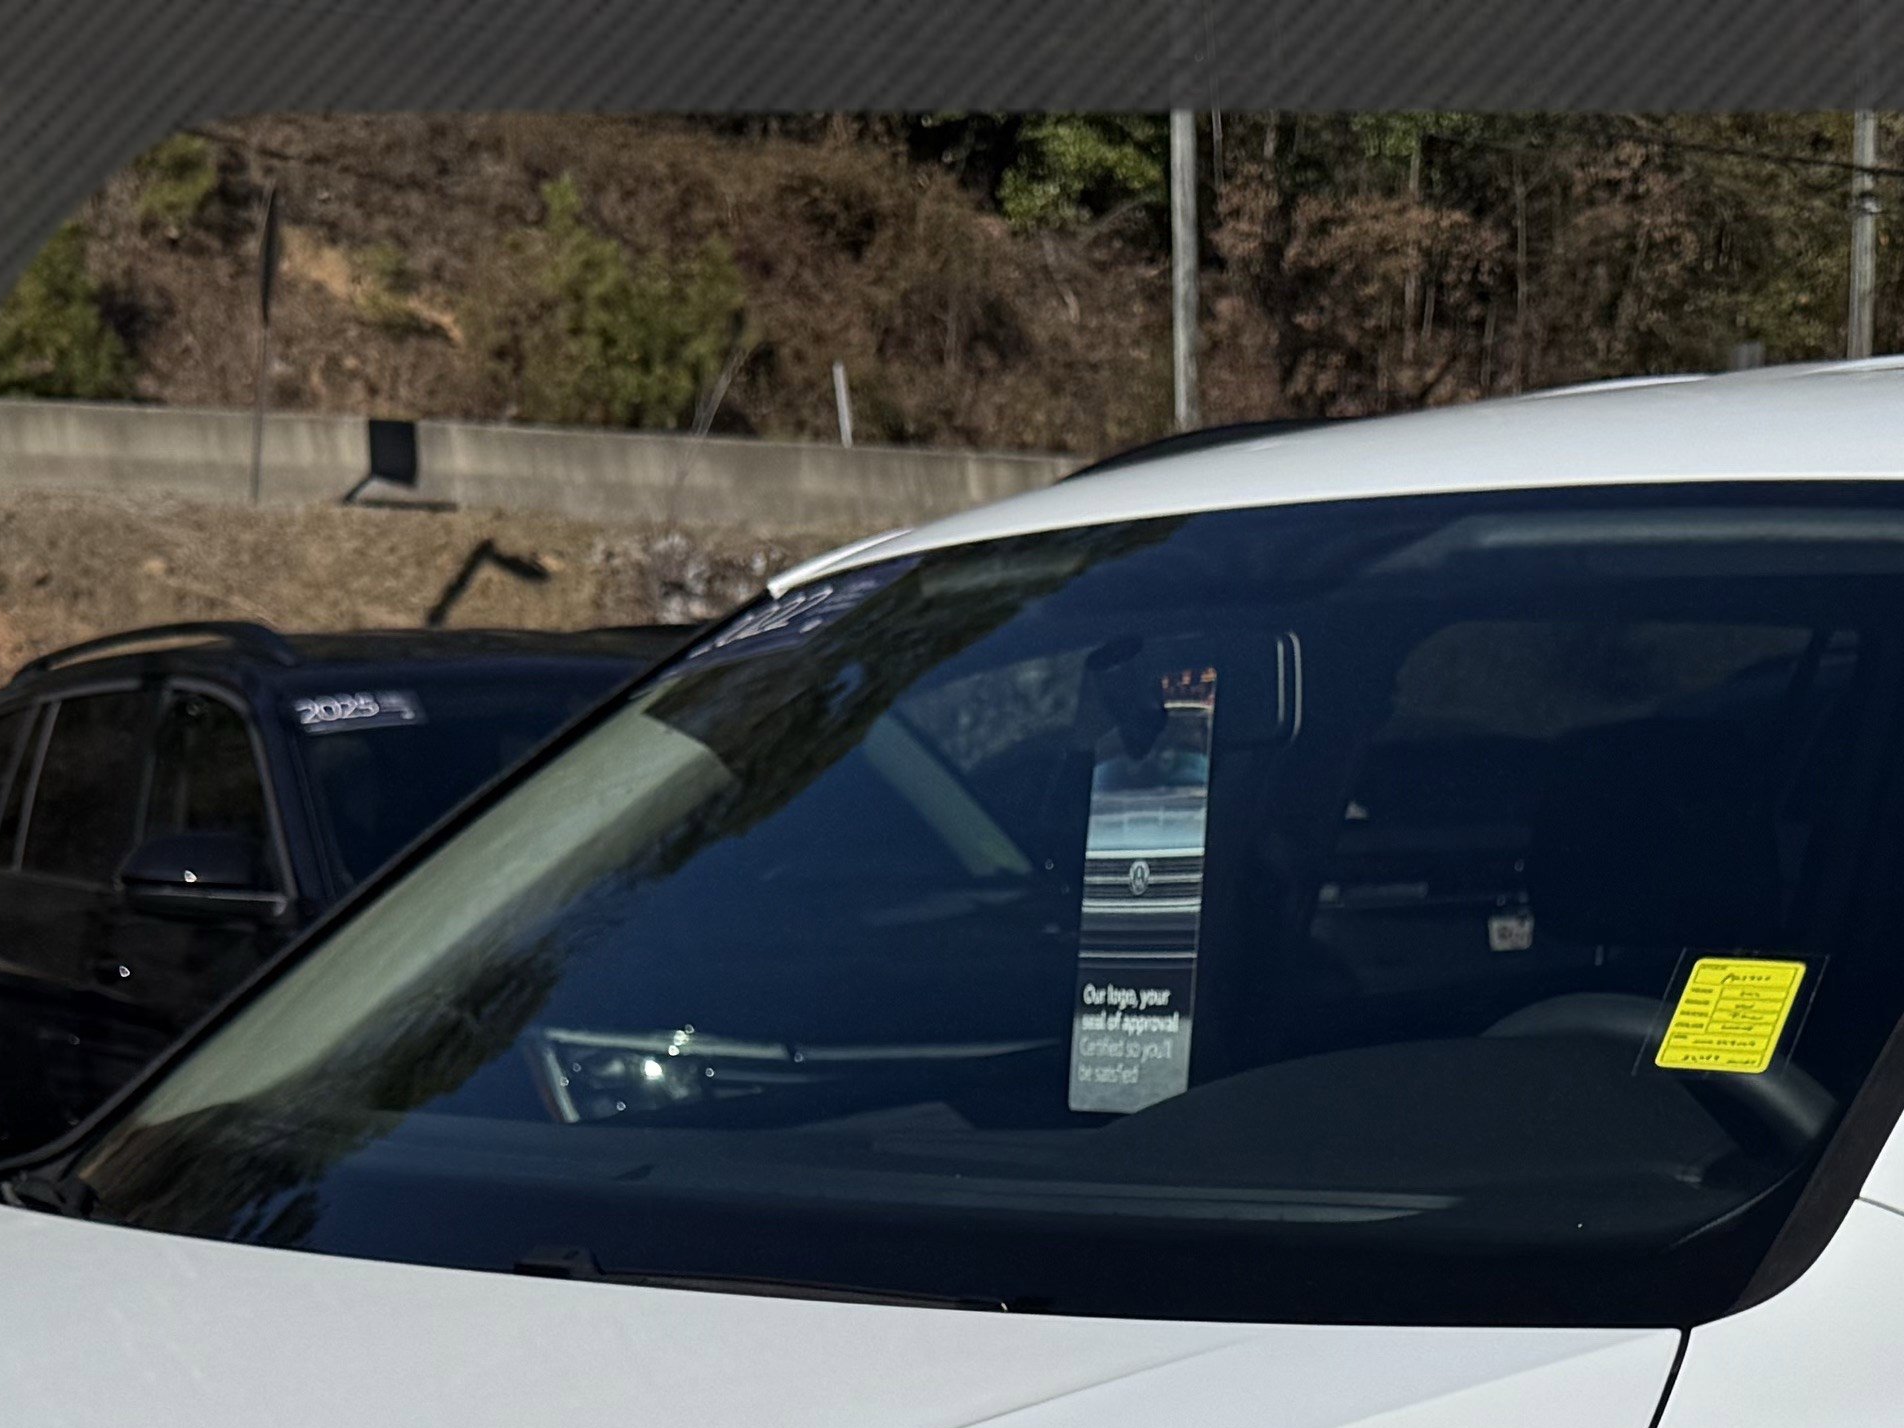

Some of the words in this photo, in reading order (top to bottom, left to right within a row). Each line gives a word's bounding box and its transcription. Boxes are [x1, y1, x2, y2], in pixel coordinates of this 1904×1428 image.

[294, 691, 380, 725] 2025
[1082, 983, 1106, 1005] Our
[1139, 988, 1171, 1010] your
[1081, 1010, 1106, 1031] seal
[1107, 1010, 1122, 1031] of
[1122, 1011, 1180, 1036] approval
[1079, 1035, 1124, 1057] Certified
[1126, 1040, 1140, 1058] so
[1077, 1063, 1092, 1082] be
[1094, 1063, 1139, 1084] satisfied
